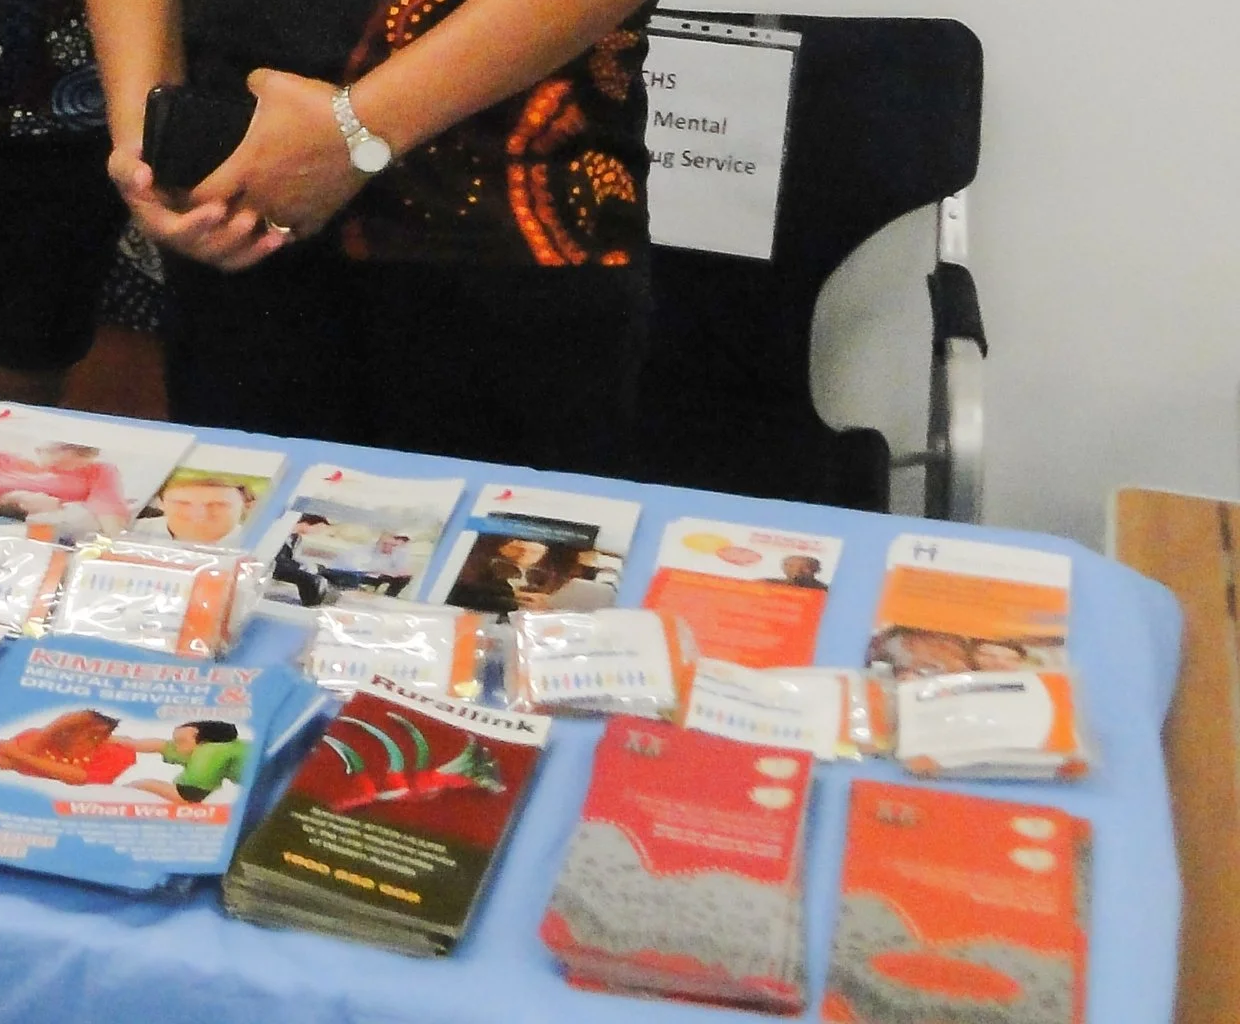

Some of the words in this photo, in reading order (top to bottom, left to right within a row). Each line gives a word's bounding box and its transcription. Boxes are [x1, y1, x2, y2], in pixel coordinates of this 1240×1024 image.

[653, 110, 727, 135] Mental
[650, 150, 675, 169] ug
[680, 149, 756, 175] Service
[27, 647, 262, 685] KIMBERLEY
[20, 677, 92, 697] DRUG
[99, 689, 207, 706] SERVICE
[24, 665, 115, 689] MENTAL
[120, 679, 211, 697] HEALTH
[371, 673, 536, 734] Rurallink
[69, 801, 128, 817] What
[134, 803, 169, 818] We
[174, 803, 217, 820] Do!
